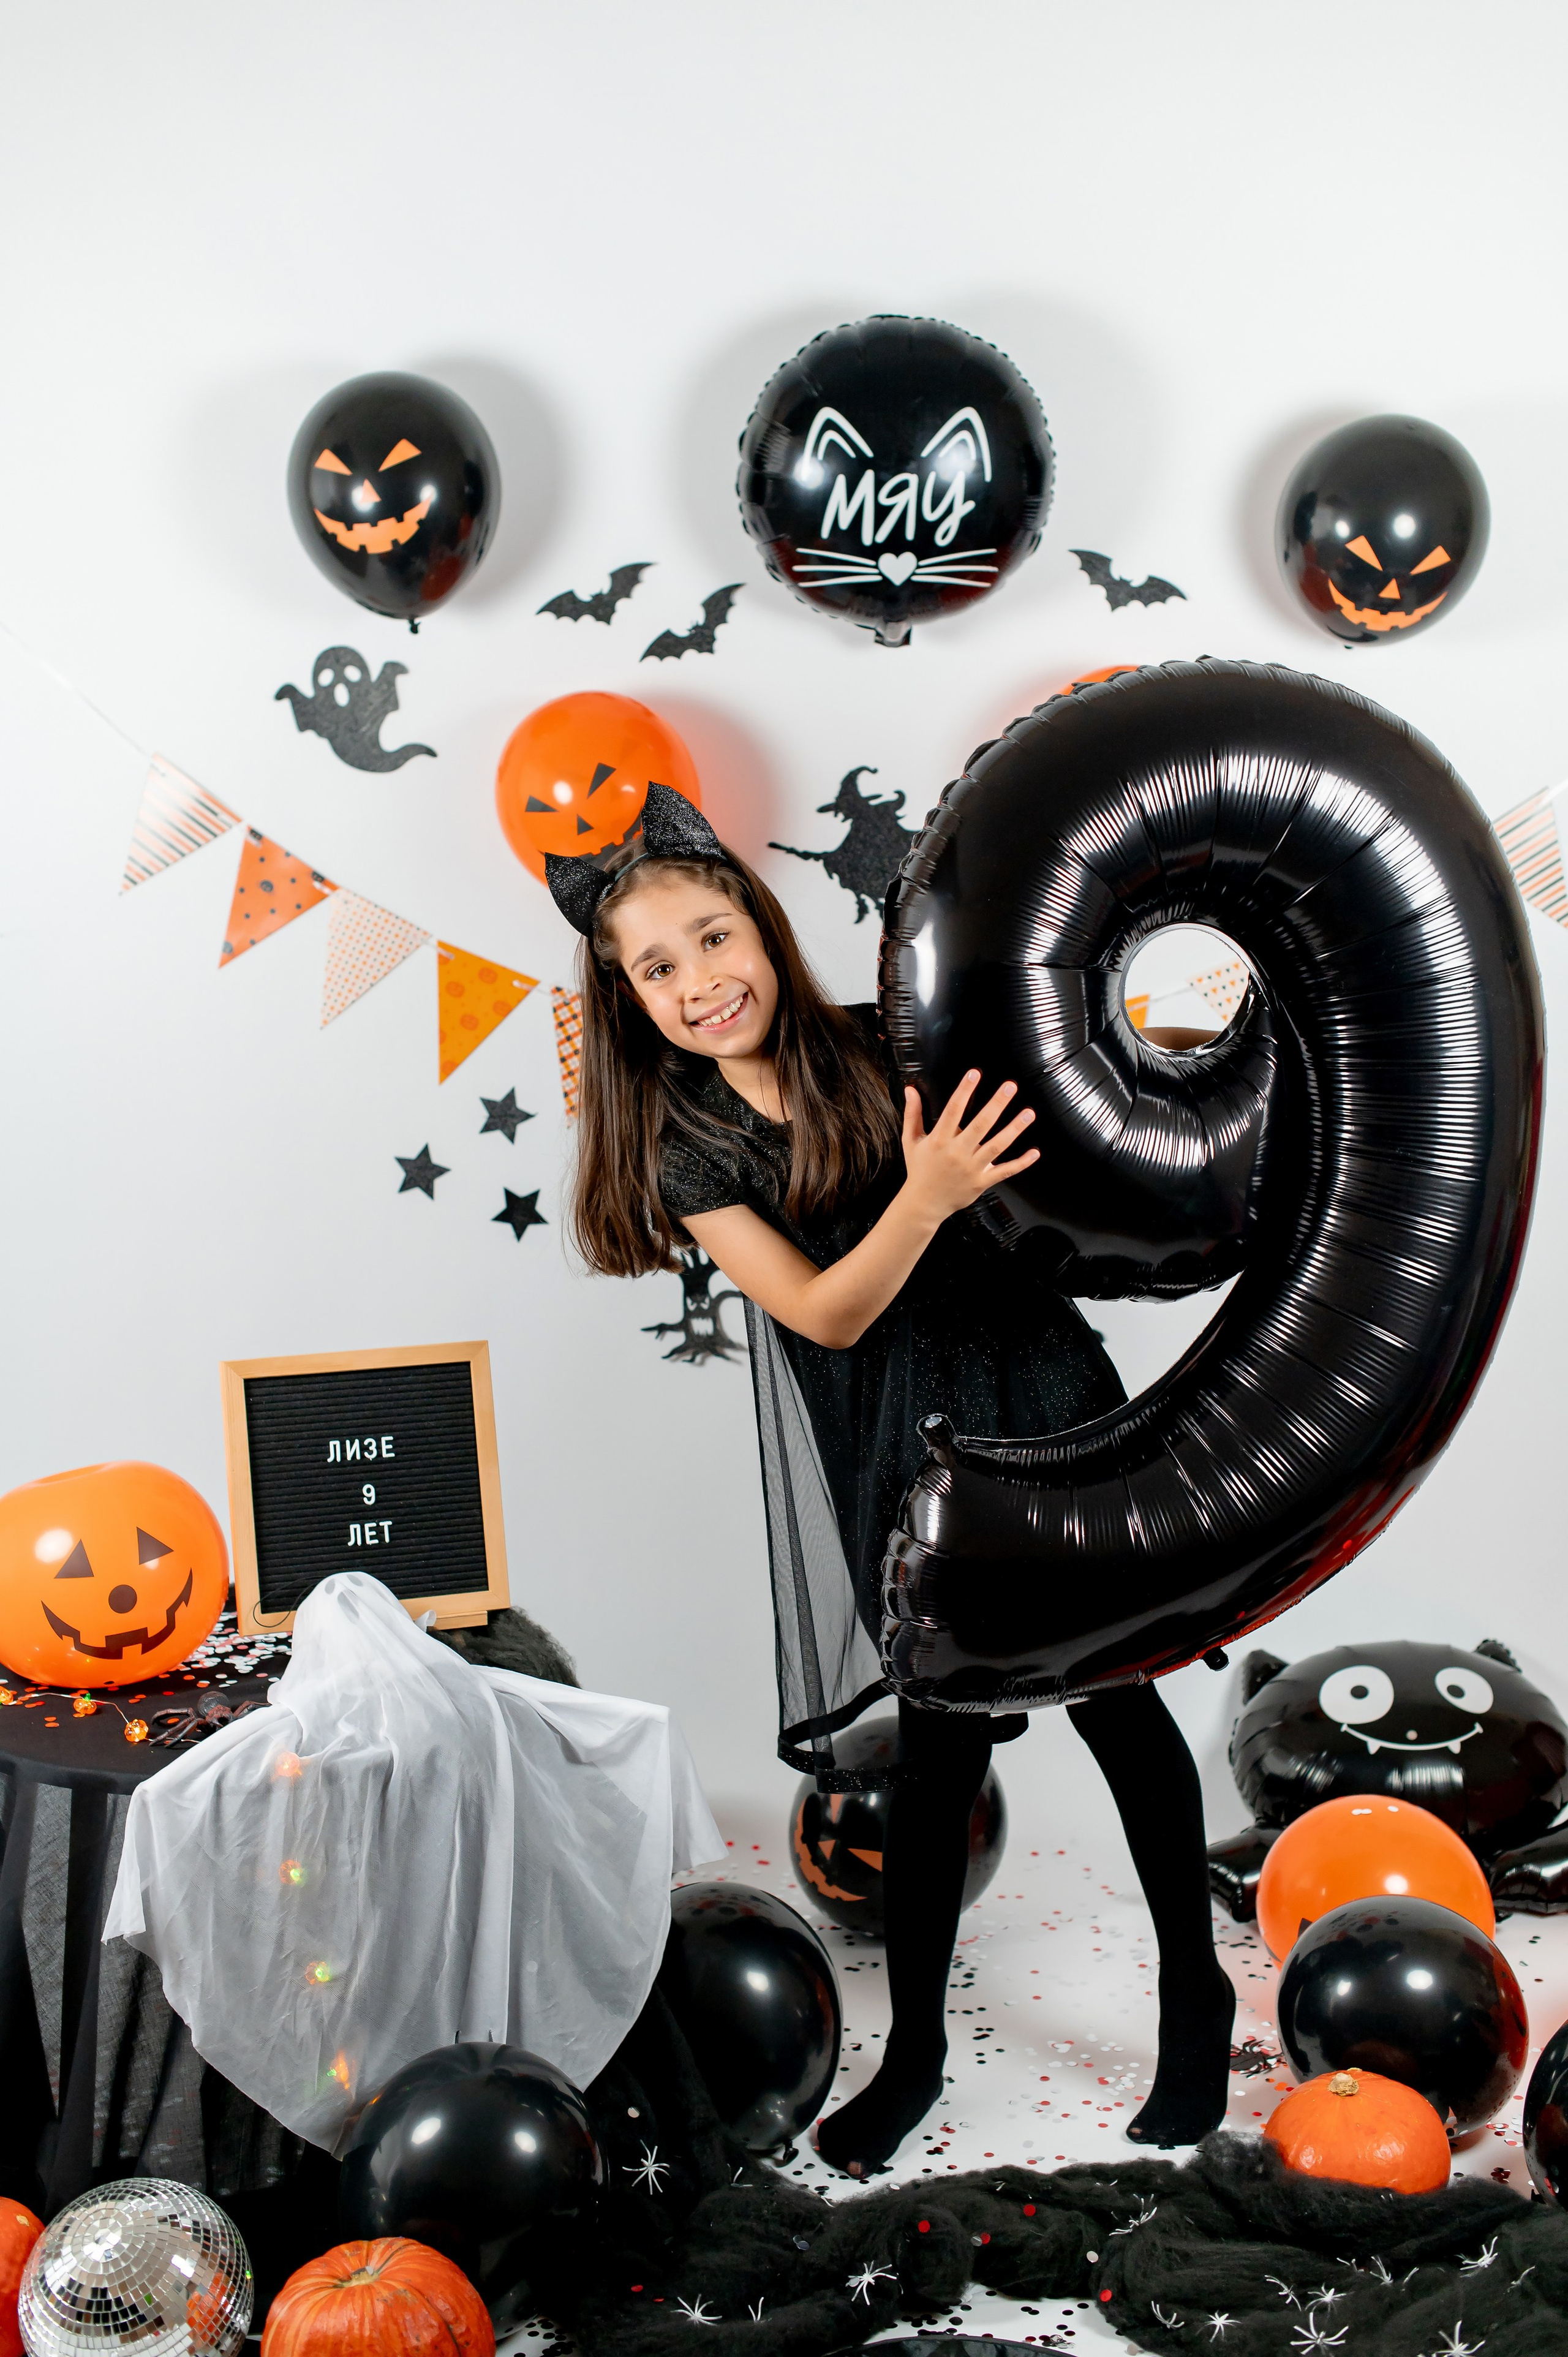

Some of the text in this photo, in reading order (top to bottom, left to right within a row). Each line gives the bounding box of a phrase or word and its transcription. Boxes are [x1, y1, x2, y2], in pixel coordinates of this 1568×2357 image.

[879, 657, 1545, 1714] 9
[326, 1436, 396, 1463] ЛИЗЕ
[362, 1484, 376, 1506] 9
[347, 1520, 393, 1547] ЛЕТ
